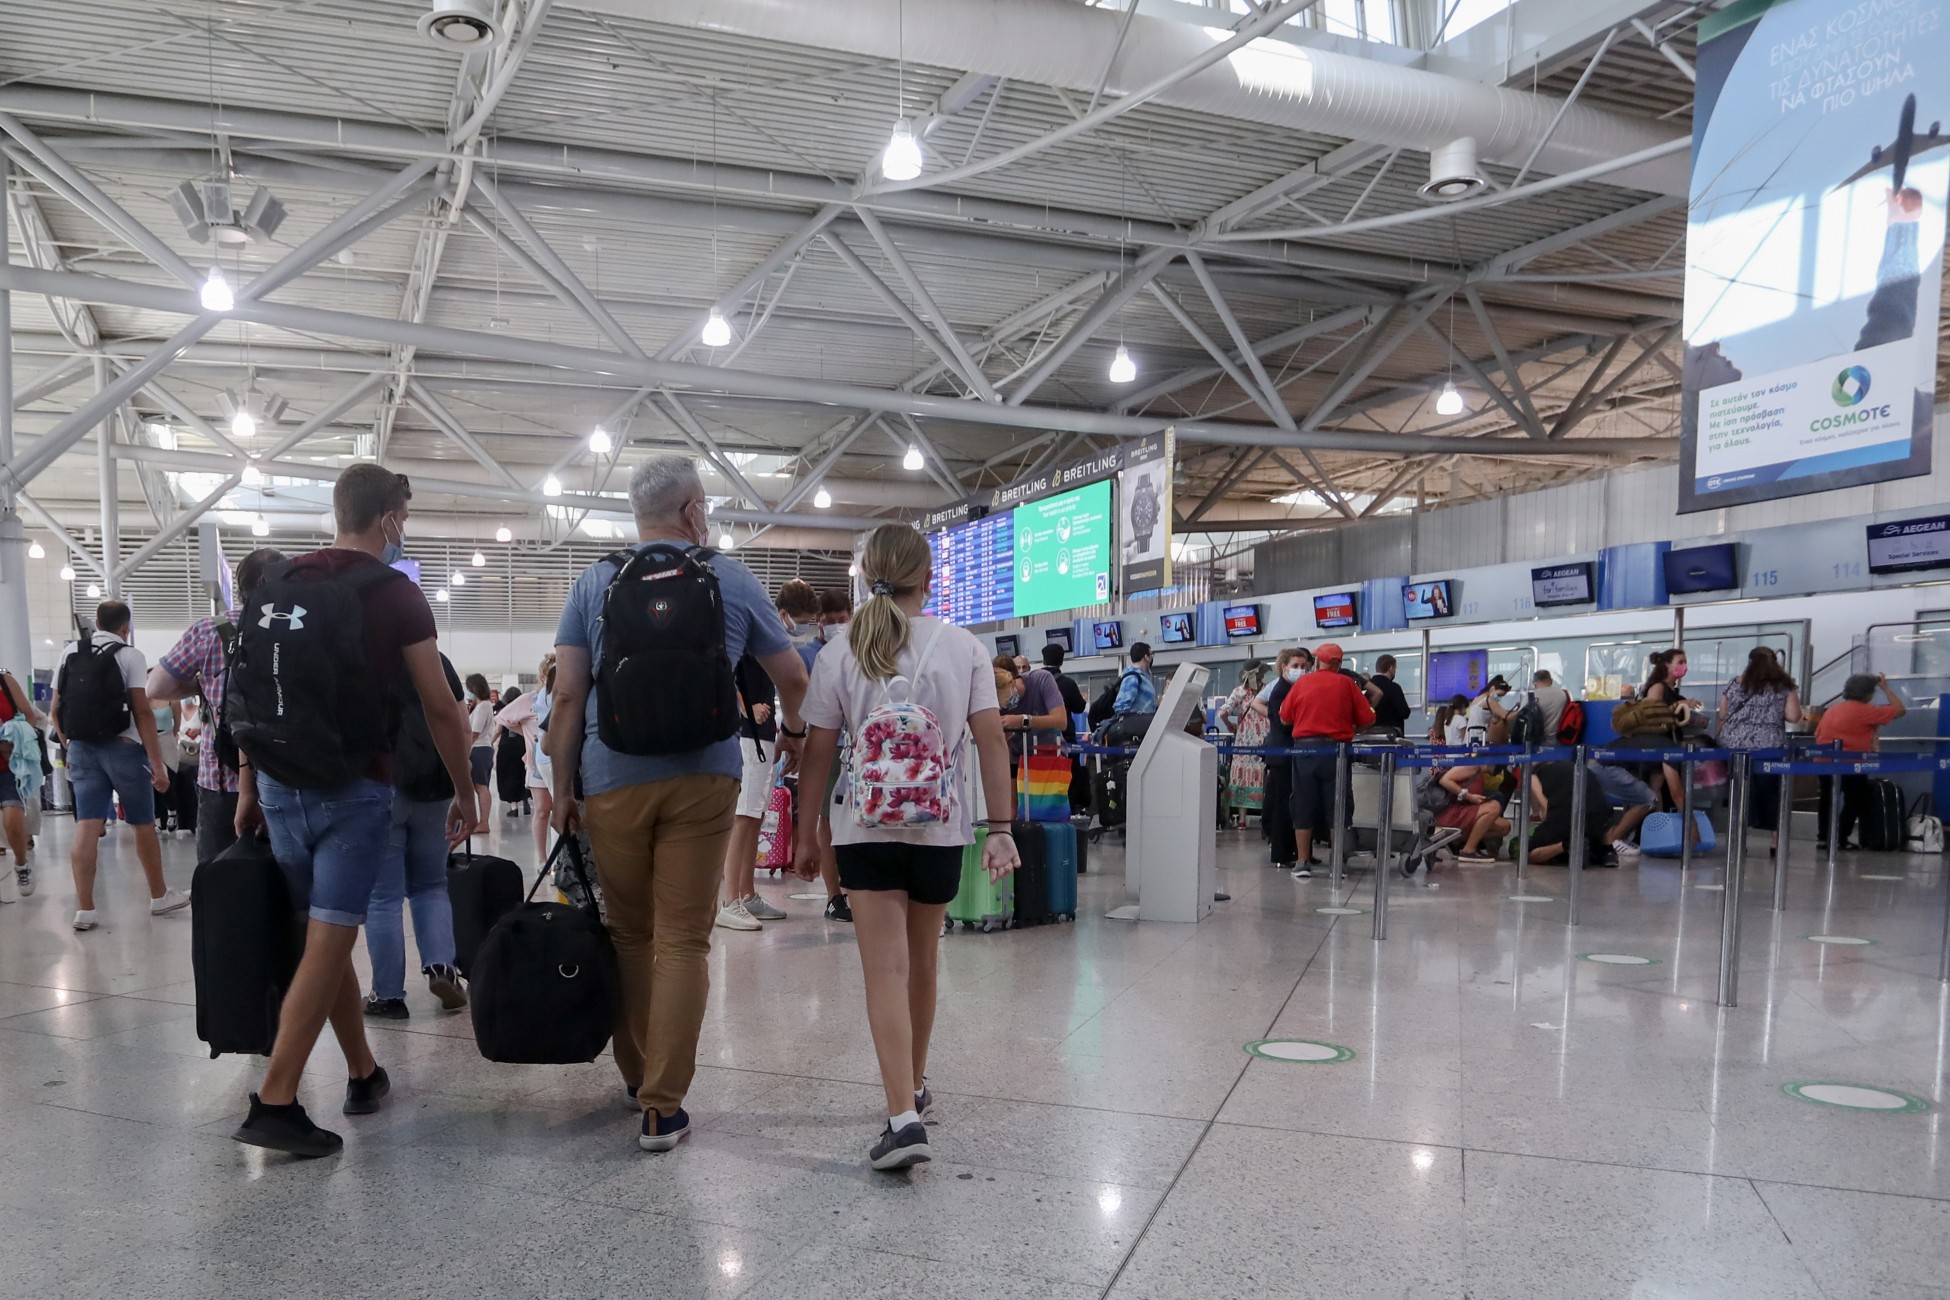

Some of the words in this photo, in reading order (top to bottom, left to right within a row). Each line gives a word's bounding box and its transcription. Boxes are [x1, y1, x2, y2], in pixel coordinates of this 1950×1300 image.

[1770, 26, 1818, 66] ΕΝΑΣ
[1826, 0, 1910, 39] ΚΟΣΜ
[1769, 75, 1792, 100] ΤΙΣ
[1798, 6, 1942, 90] ΔΥΝΑΤΟΤΗΤΕΣ
[1781, 91, 1805, 114] ΝΑ
[1811, 48, 1901, 98] ΦΤΑΣΟΥΝ
[1823, 88, 1855, 114] ΠΙΟ
[1862, 63, 1915, 96] ΨΗΛΑ
[1710, 399, 1719, 408] Σε
[1722, 391, 1748, 405] αυτόν
[1751, 389, 1766, 399] τον
[1769, 381, 1798, 394] κόσμο
[1709, 402, 1760, 418] πιστεύουμε.
[1810, 404, 1891, 432] COSMOTE
[1709, 420, 1721, 430] Με
[1740, 407, 1785, 424] πρόσβαση
[1709, 430, 1728, 441] στην
[1131, 443, 1157, 458] BREITLING
[1708, 442, 1721, 453] για
[1064, 455, 1117, 482] BREITLING
[1002, 478, 1046, 502] BREITLING
[932, 503, 968, 524] BREITLING
[1902, 521, 1946, 534] AEGEAN
[1912, 550, 1939, 558] Services
[1553, 568, 1579, 577] AEGEAN
[1832, 561, 1861, 578] 114
[1753, 570, 1778, 586] 115
[1326, 610, 1341, 618] FREE
[1463, 601, 1479, 615] 117
[1235, 620, 1247, 628] FREE
